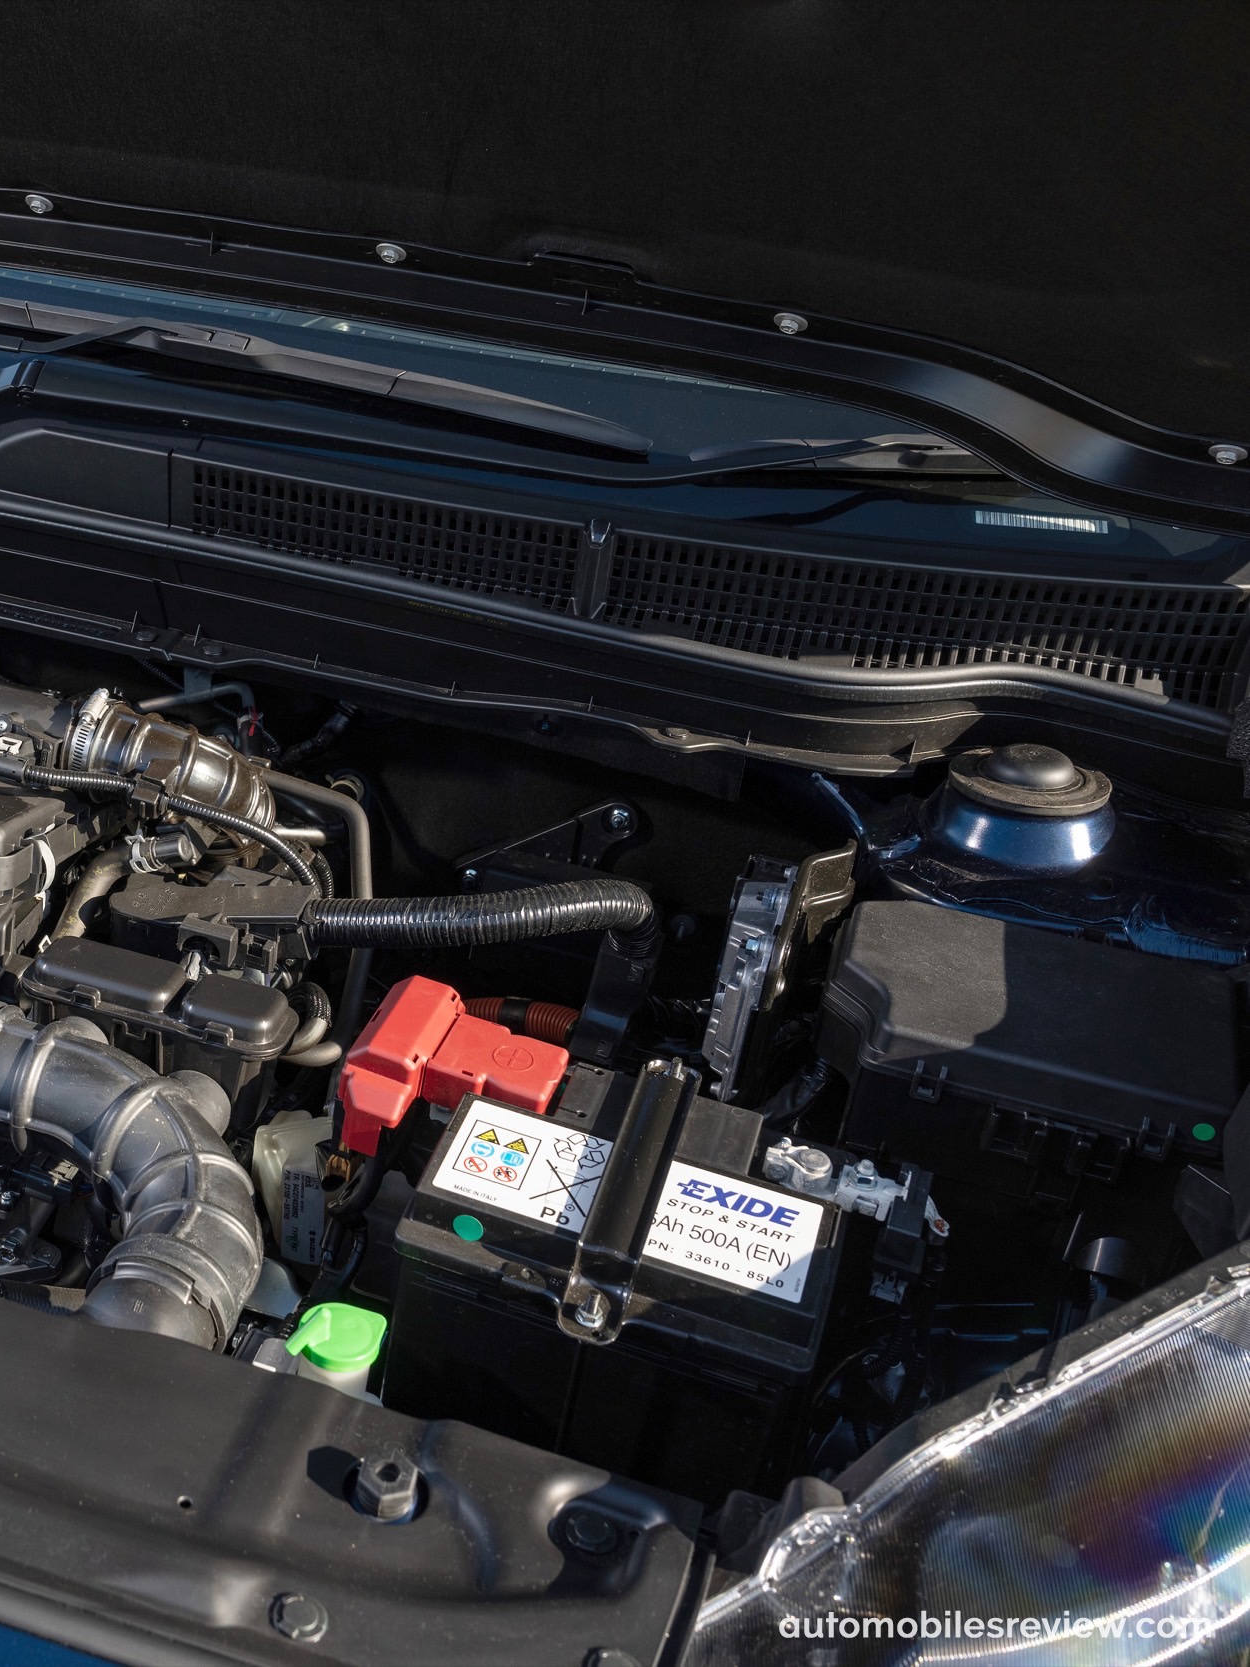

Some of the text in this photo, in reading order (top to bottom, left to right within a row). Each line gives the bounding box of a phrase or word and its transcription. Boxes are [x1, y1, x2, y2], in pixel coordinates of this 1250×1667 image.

[453, 1184, 471, 1195] MADE
[480, 1193, 497, 1201] ITALY
[540, 1206, 570, 1225] Pb
[677, 1179, 800, 1227] EXIDE
[667, 1198, 795, 1243] STOP & START
[647, 1239, 674, 1253] PN:
[685, 1250, 730, 1271] 33610
[746, 1270, 784, 1288] 85L0
[689, 1224, 740, 1253] 500A
[746, 1242, 791, 1272] (EN)
